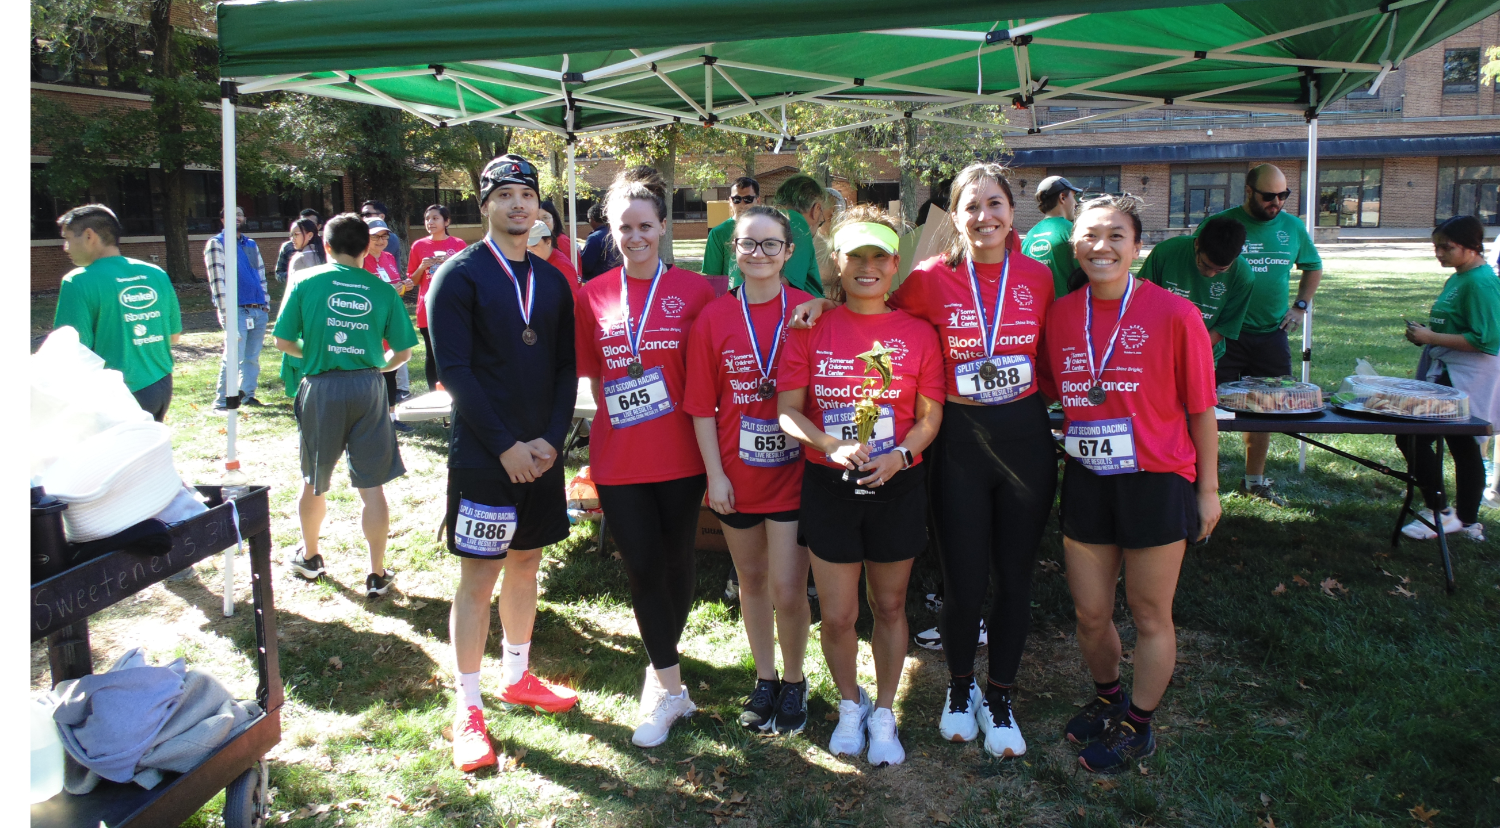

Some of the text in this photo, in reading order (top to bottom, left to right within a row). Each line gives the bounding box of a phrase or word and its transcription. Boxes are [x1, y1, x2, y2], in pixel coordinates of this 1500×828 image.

[1264, 257, 1290, 265] Cancer
[332, 280, 362, 288] Sponsored
[123, 291, 154, 303] Henkel
[332, 298, 368, 311] Henkel
[124, 311, 160, 322] Nouryon
[1202, 312, 1213, 320] cer
[327, 317, 369, 330] Nouryon
[996, 334, 1035, 346] ancer
[328, 345, 365, 355] Ingredion
[606, 354, 641, 370] United
[958, 363, 974, 373] SPLIT
[1002, 355, 1025, 365] RACING
[604, 372, 660, 394] SPLIT SECOND RACING
[971, 368, 1020, 391] 1888
[1062, 379, 1090, 392] Blood
[814, 385, 901, 398] Blood Cancer
[992, 388, 1013, 397] RESULTS
[618, 388, 650, 410] 645
[817, 398, 855, 409] United
[1062, 395, 1098, 407] Unite
[633, 405, 652, 415] RESULTS
[824, 412, 855, 424] SPLIT SECO
[742, 420, 779, 432] SPLIT SECOND
[1079, 426, 1100, 435] SECOND
[1102, 424, 1128, 434] RACING
[754, 435, 786, 451] 653
[1078, 439, 1113, 456] 674
[460, 505, 515, 520] SPLIT SECOND RACING
[466, 520, 506, 540] 1886
[34, 537, 196, 630] Sweeteners
